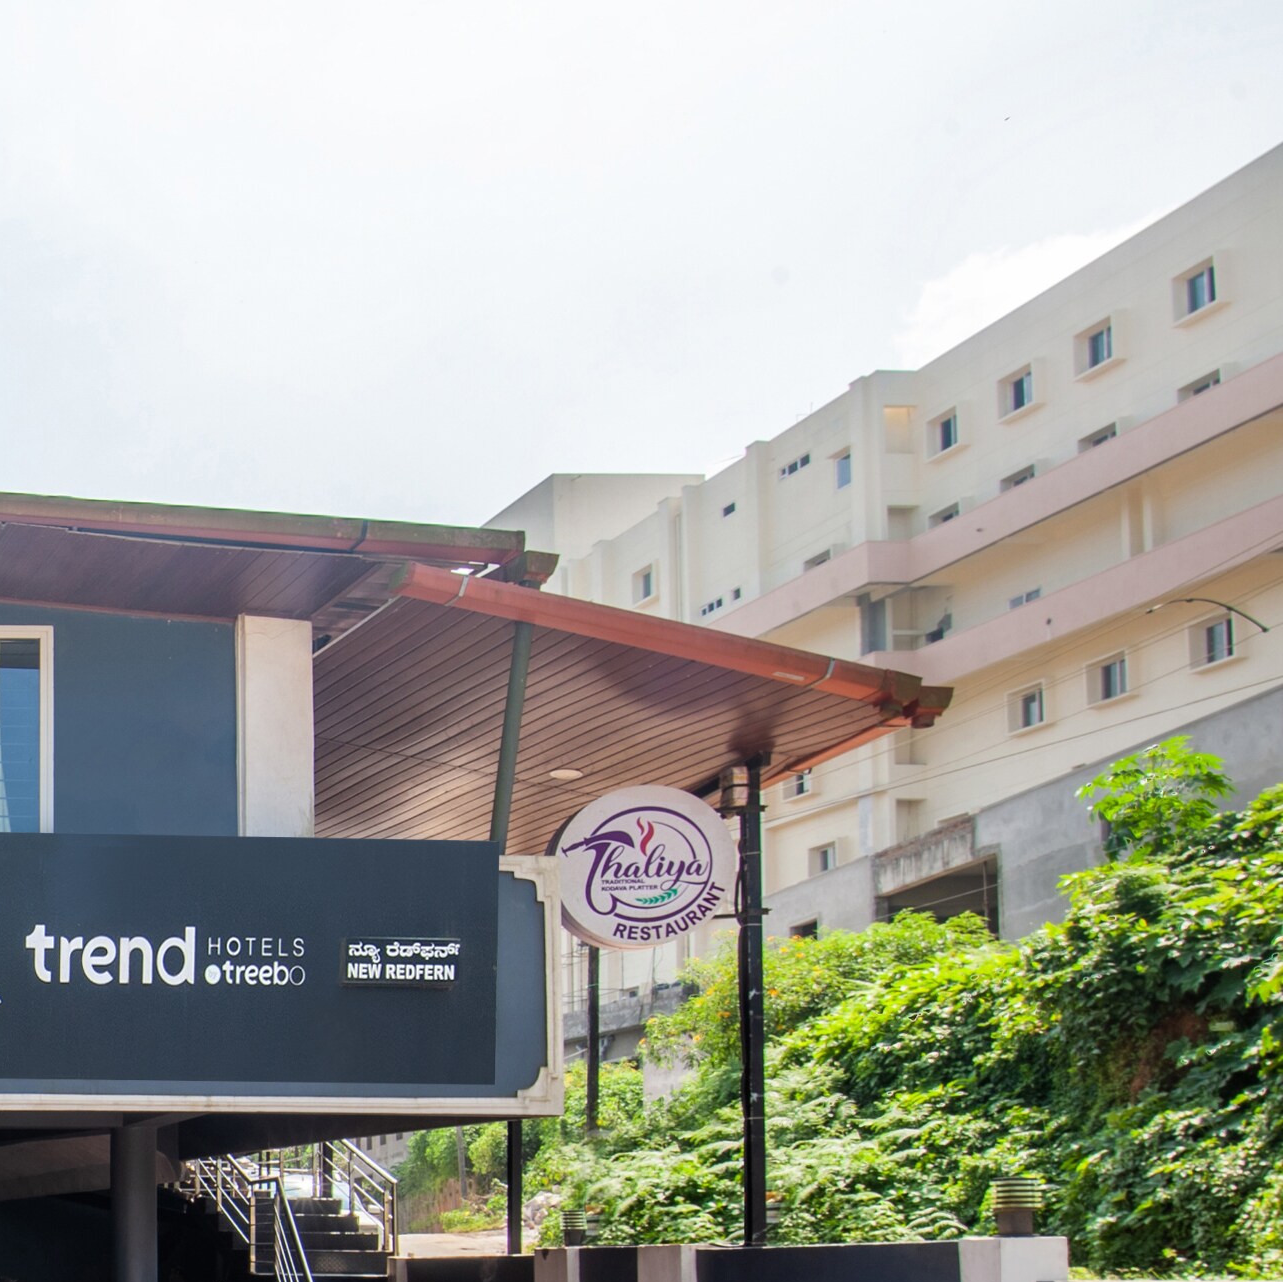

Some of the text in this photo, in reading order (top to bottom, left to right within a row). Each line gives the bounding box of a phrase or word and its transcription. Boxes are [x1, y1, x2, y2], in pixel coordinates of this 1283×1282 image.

[583, 838, 709, 903] Thaliya
[613, 881, 725, 941] RESTAURANT
[25, 924, 196, 986] trend
[208, 936, 305, 957] HOTELS
[222, 960, 306, 986] treebo
[347, 963, 455, 981] NEW REDFERN
